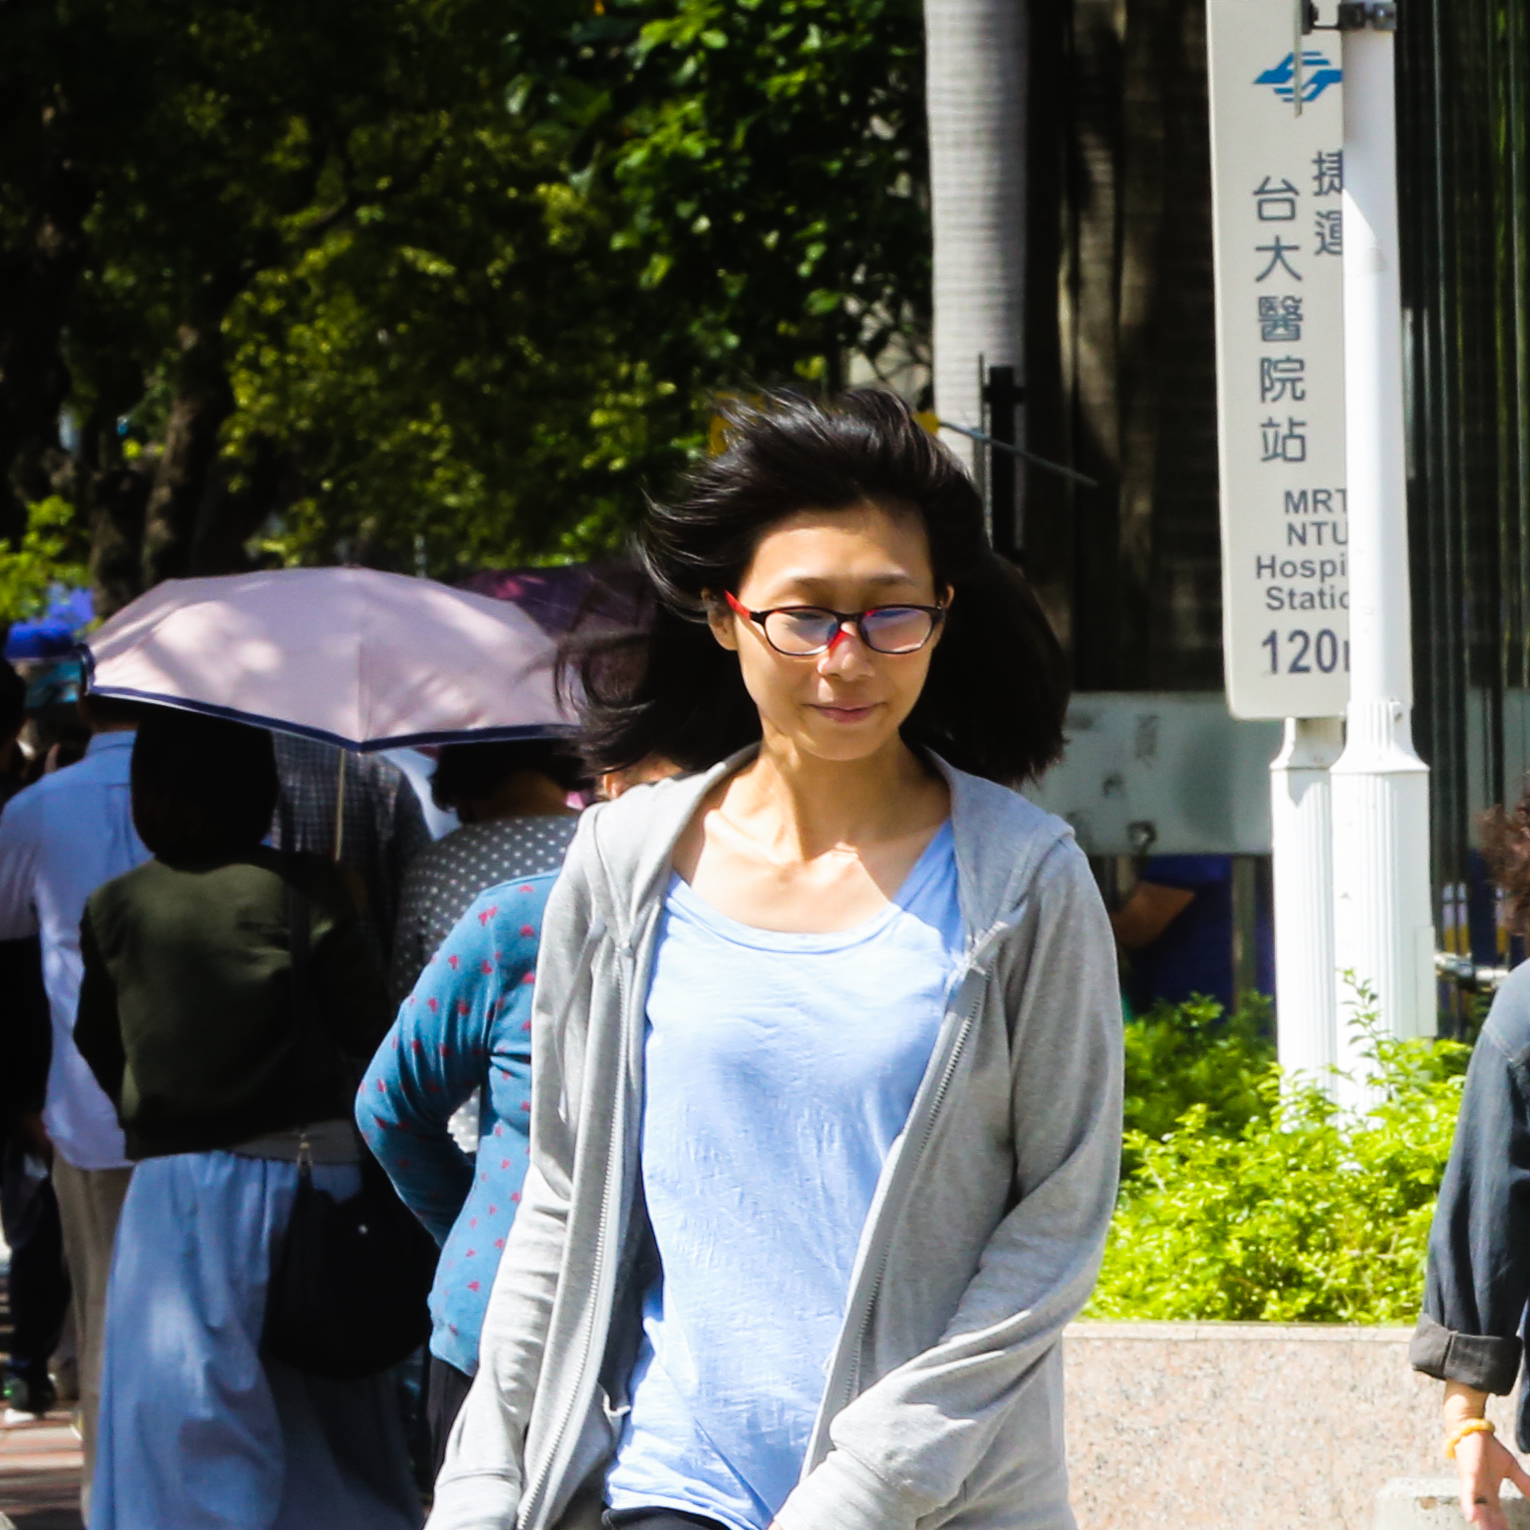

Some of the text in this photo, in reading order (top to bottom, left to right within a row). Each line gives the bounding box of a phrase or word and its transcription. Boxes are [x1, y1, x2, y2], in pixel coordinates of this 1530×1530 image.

[1253, 175, 1307, 463] 台大醫院站
[1284, 488, 1348, 516] MRT
[1287, 521, 1349, 546] NTU
[1256, 554, 1347, 584] Hospi
[1265, 585, 1350, 611] Statio
[1261, 628, 1350, 675] 120
